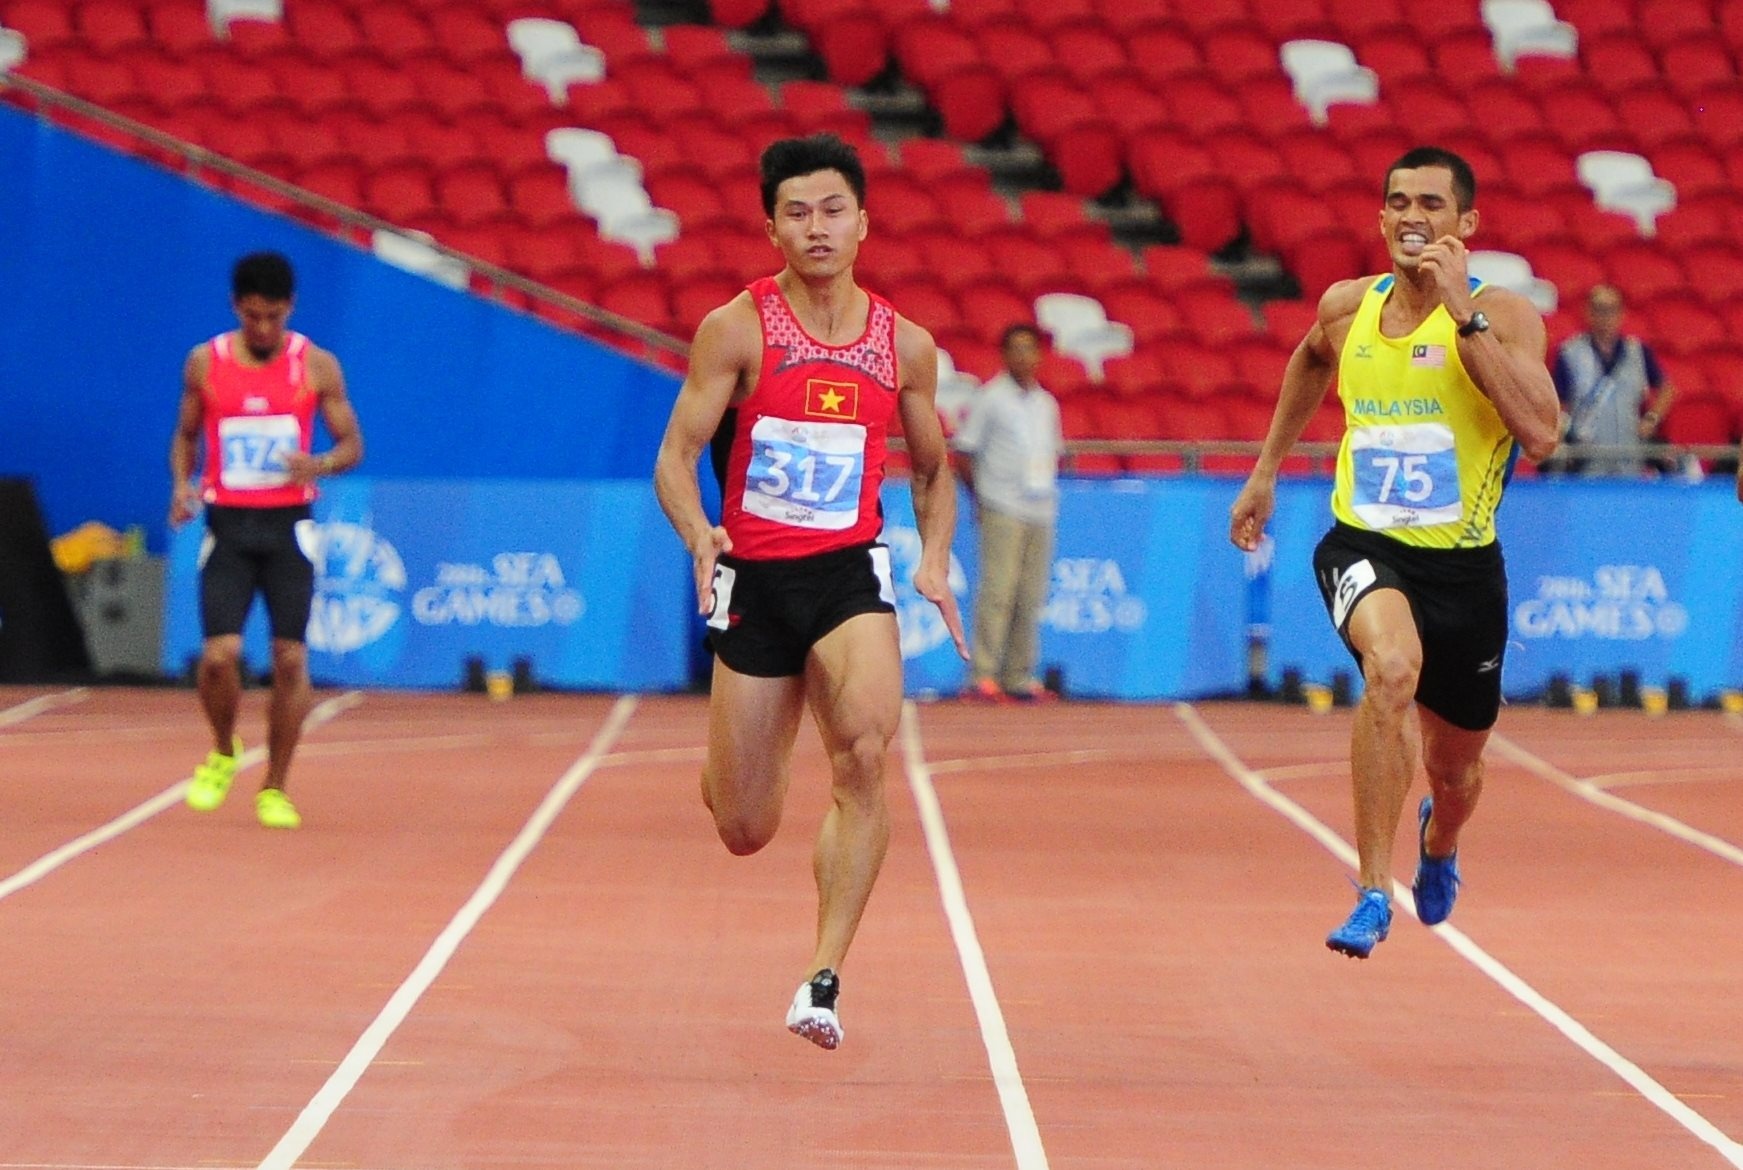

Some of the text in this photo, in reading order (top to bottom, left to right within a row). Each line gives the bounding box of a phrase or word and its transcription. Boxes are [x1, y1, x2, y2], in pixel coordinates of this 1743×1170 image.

[1354, 398, 1444, 416] MALAYSIA
[758, 448, 855, 502] 317
[1371, 455, 1433, 502] 75
[492, 552, 565, 586] SEA
[1594, 564, 1668, 599] SEA
[412, 587, 551, 627] GAMES
[1514, 600, 1655, 641] GAMES
